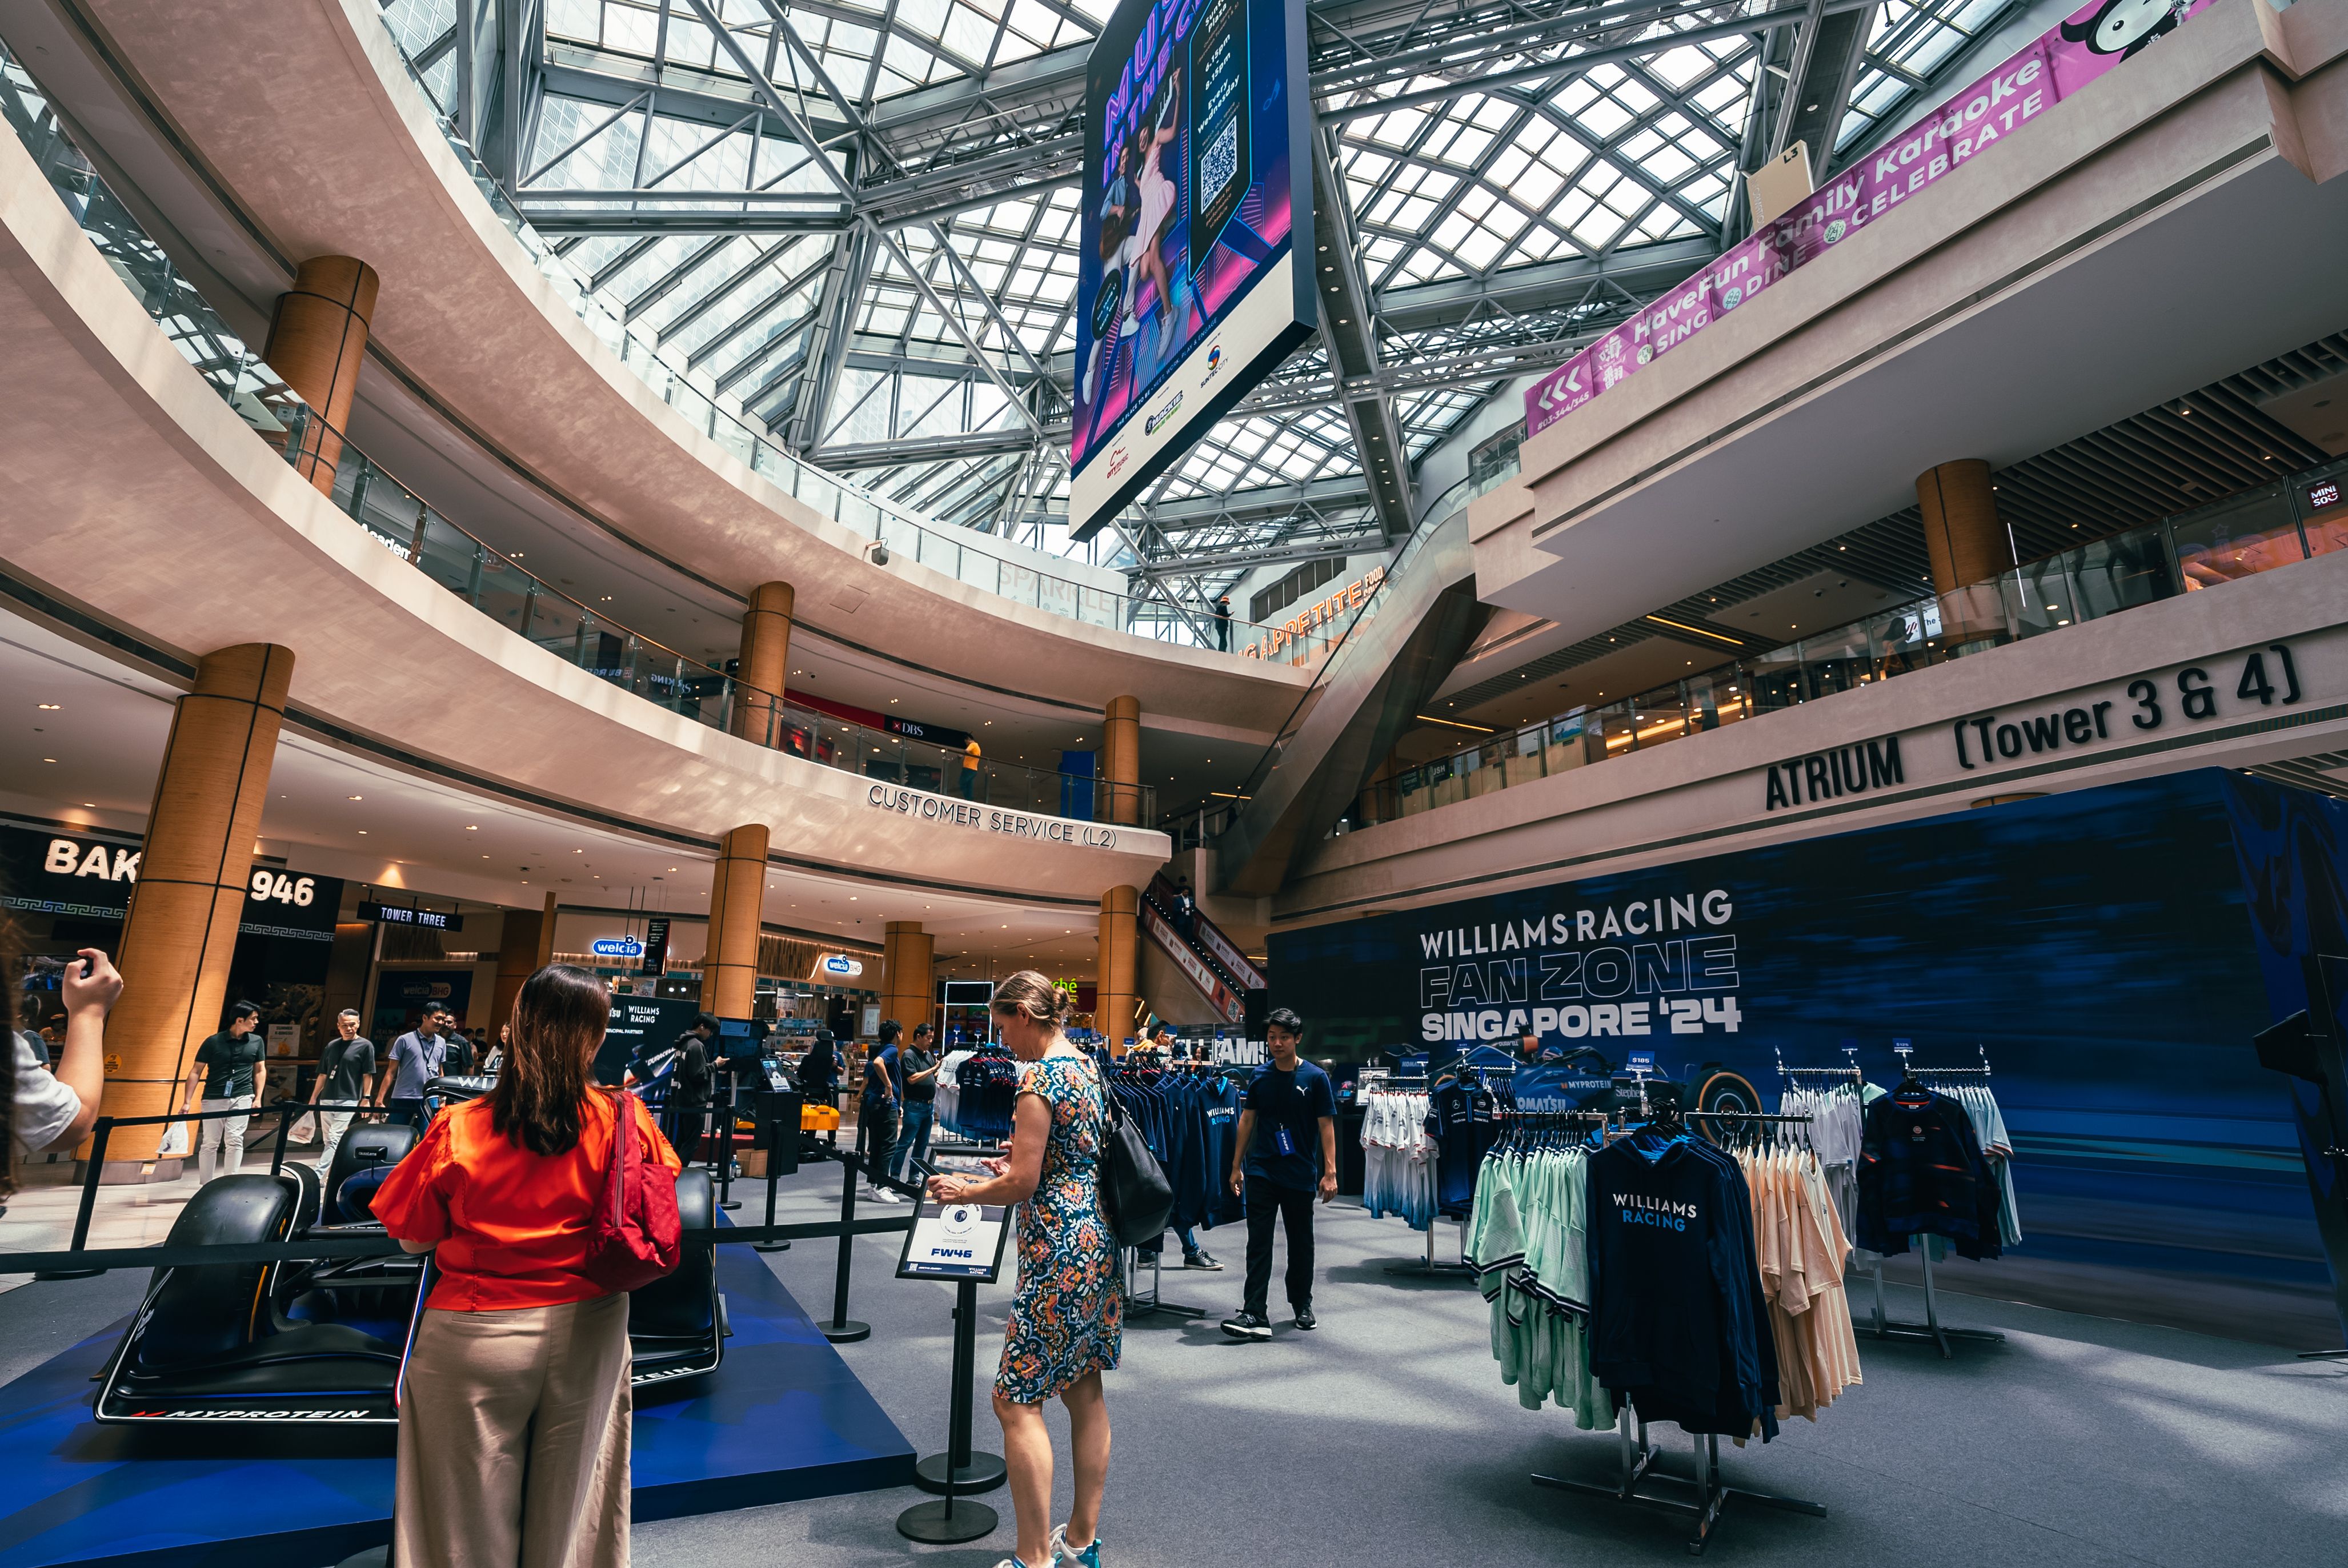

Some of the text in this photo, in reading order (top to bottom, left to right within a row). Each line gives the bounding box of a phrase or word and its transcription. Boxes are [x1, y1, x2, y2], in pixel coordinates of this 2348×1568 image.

[1209, 3, 1227, 33] Plaza
[1205, 34, 1230, 72] 6.15pm
[1128, 33, 1172, 136] THE
[1205, 53, 1231, 91] 8.15pm
[1197, 74, 1240, 134] Wednesday
[1208, 79, 1228, 110] Every
[1758, 173, 1865, 262] Family
[1875, 58, 2043, 184] Karaoke
[1783, 147, 1798, 165] L3
[1657, 89, 2044, 354] SING DINE CELEBRATE
[1125, 404, 1137, 419] PLACE
[1139, 396, 1144, 405] TO
[1181, 344, 1193, 358] PLAY
[1198, 316, 1217, 341] ENGAGE
[1200, 356, 1229, 388] SUNTEC CITY
[1151, 390, 1184, 428] MACKIE
[1537, 391, 1589, 430] #03-344/345
[2311, 485, 2337, 499] MINI
[999, 564, 1117, 614] SPARKLE
[1365, 565, 1384, 588] FOOD
[1259, 579, 1364, 661] APPETITE
[903, 722, 924, 737] DBS
[1766, 644, 2303, 812] ATRIUM (Tower 3 & 4)
[869, 785, 1117, 849] CUSTOMER SERVICE (L2)
[380, 907, 447, 928] TOWER THREE
[1420, 889, 1733, 960] WILLIAMS RACING
[598, 943, 637, 953] welcia
[830, 961, 848, 971] welcia
[1420, 934, 1740, 1009] FAN ZONE
[403, 985, 449, 996] welcia BHG
[1052, 977, 1077, 993] ché
[628, 1005, 660, 1016] WILLIAMS
[630, 1014, 656, 1024] RACING
[1422, 1001, 1651, 1042] SINGAPORE
[1568, 1080, 1612, 1089] MYPROTEIN
[1616, 1086, 1648, 1098] Stephes
[1207, 1106, 1235, 1118] WILLIAMS
[1281, 1133, 1289, 1150] STAFF
[1613, 1193, 1697, 1218] WILLIAMS
[1622, 1209, 1686, 1232] RACING
[931, 1248, 973, 1258] FW46
[165, 1410, 370, 1419] MYPROTEIN
